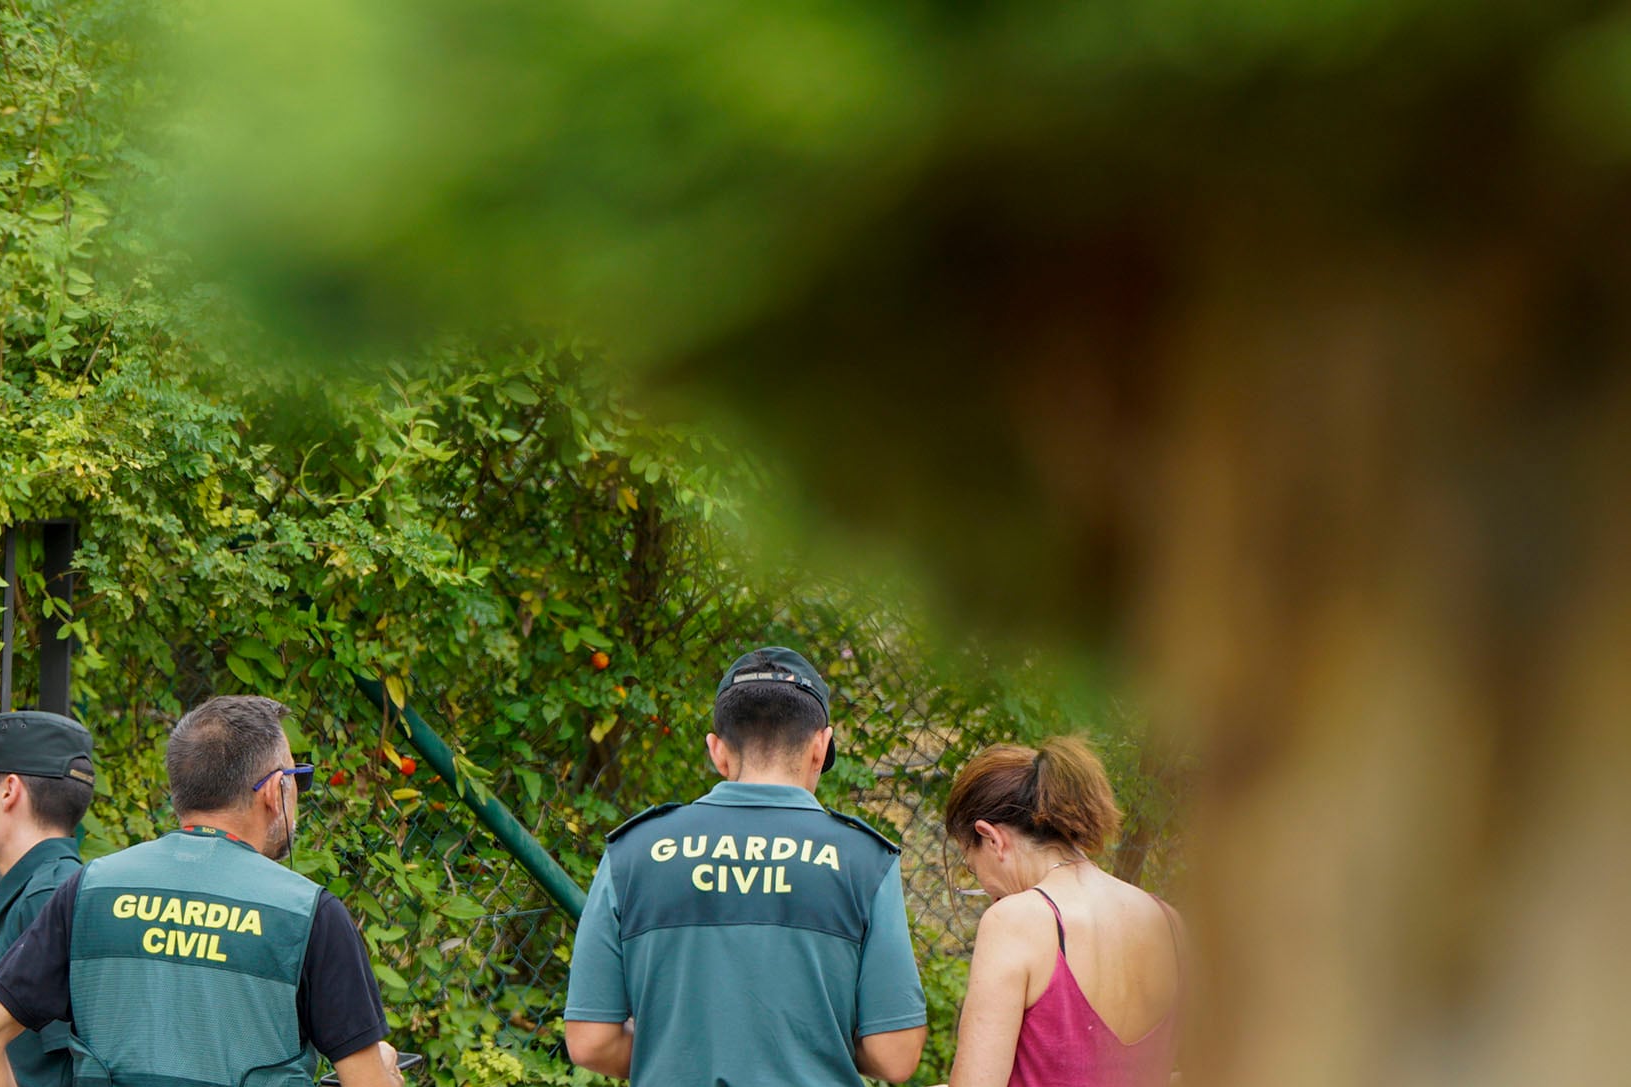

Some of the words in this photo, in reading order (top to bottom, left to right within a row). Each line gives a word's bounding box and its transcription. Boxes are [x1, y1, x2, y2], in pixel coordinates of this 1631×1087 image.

[650, 835, 840, 871] GUARDIA
[691, 863, 792, 894] CIVIL
[112, 894, 263, 936] GUARDIA
[142, 927, 228, 962] CIVIL
